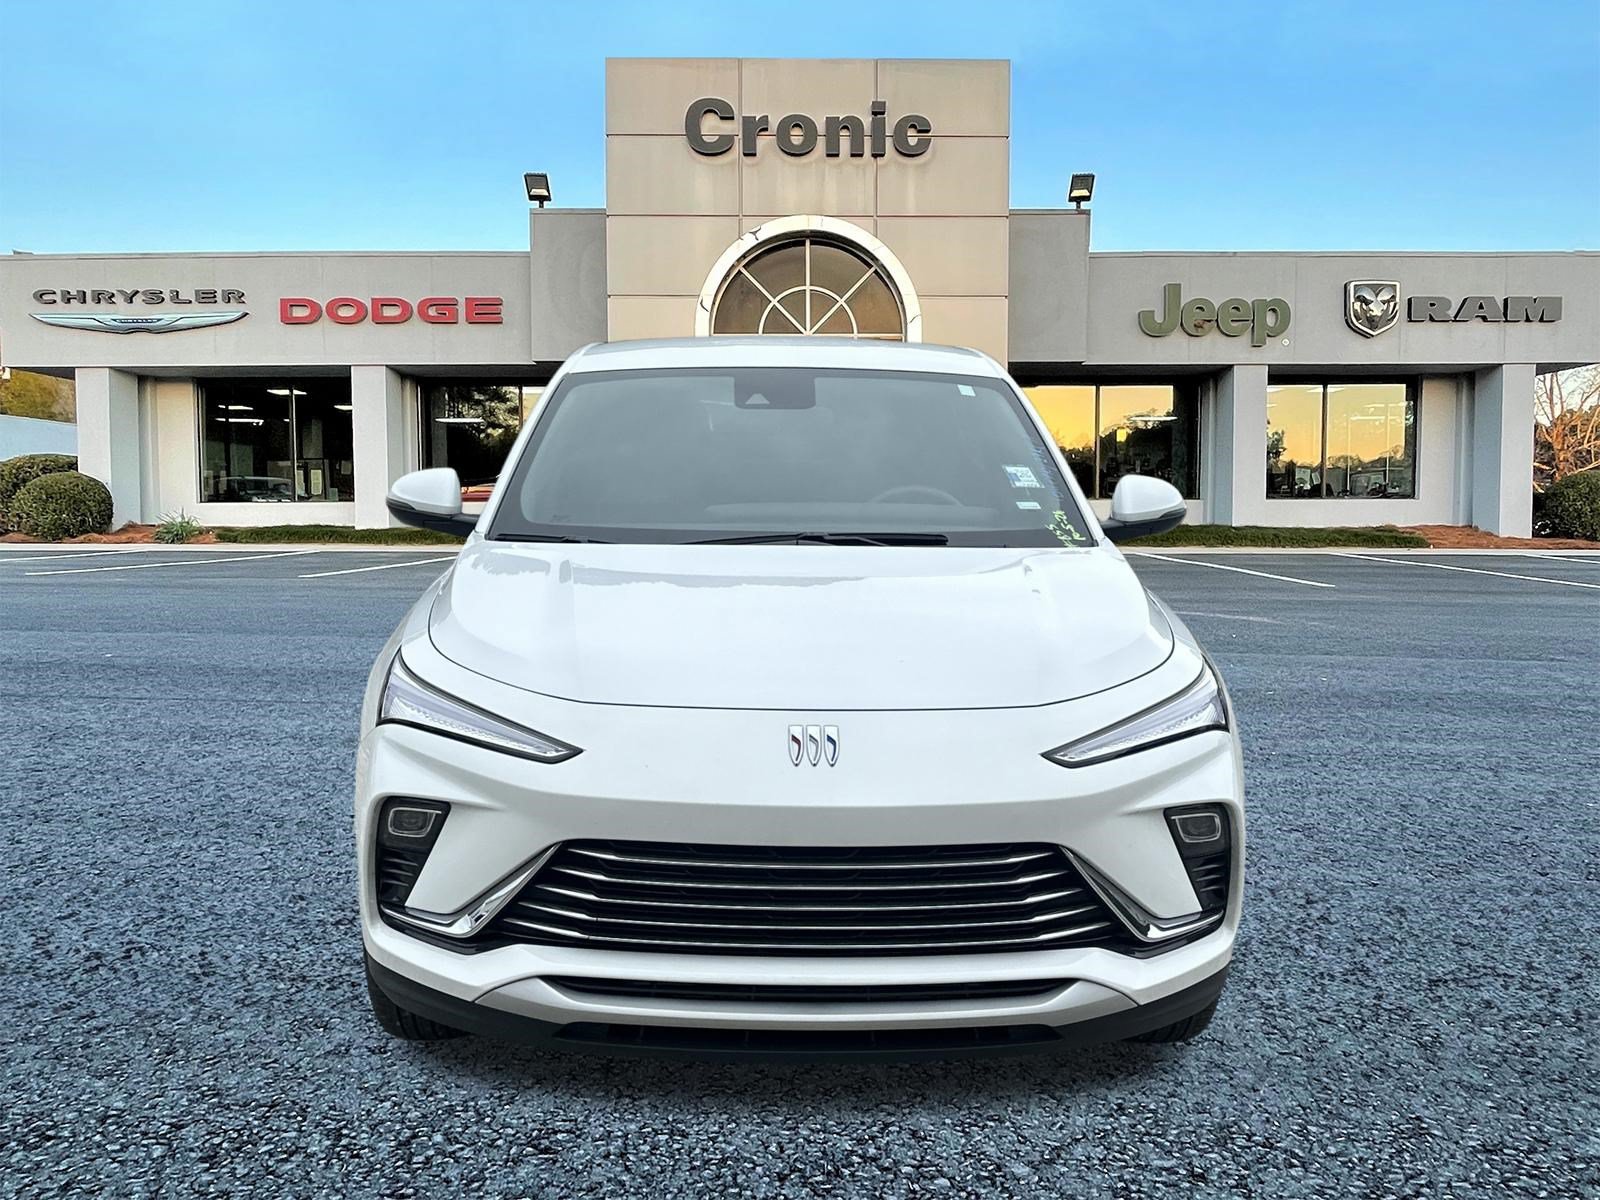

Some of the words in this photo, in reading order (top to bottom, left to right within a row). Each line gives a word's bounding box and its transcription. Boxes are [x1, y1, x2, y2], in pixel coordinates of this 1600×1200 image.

[685, 97, 932, 157] Cronic
[33, 289, 246, 304] CHRYSLER
[1408, 296, 1562, 322] RAM
[280, 297, 503, 324] DODGE
[1138, 283, 1291, 347] Jeep
